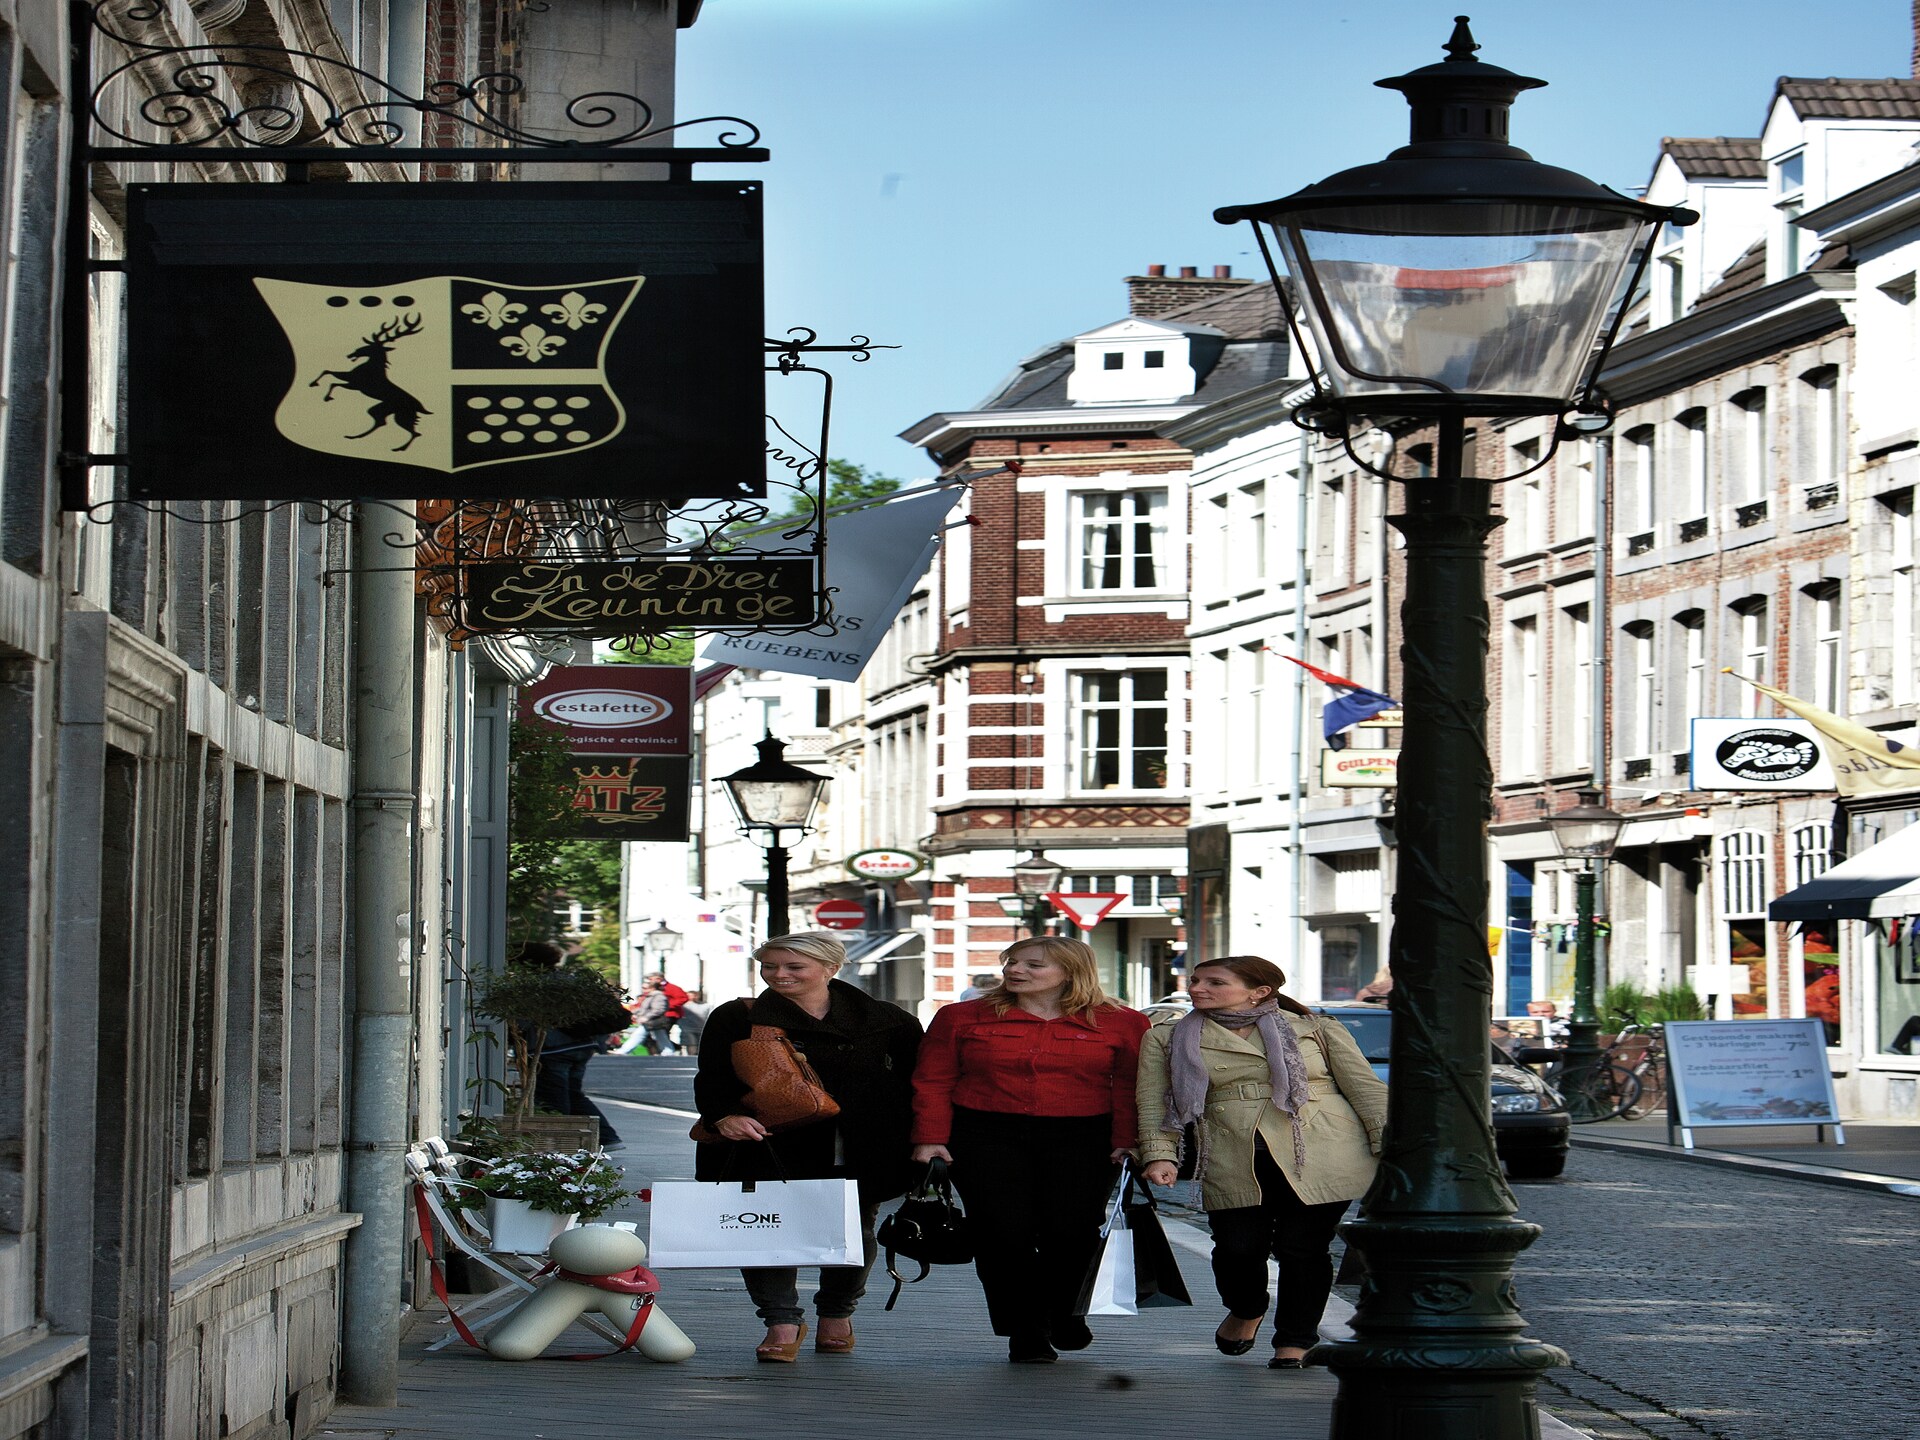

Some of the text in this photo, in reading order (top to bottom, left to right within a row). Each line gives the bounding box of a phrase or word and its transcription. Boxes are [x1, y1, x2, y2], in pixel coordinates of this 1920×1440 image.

[602, 565, 658, 591] de
[657, 563, 782, 591] Drei
[482, 585, 795, 622] Keuninge
[722, 636, 861, 667] RUEBENS
[555, 702, 652, 713] estafette
[619, 737, 678, 745] eetwinkel
[549, 785, 668, 812] ATZ
